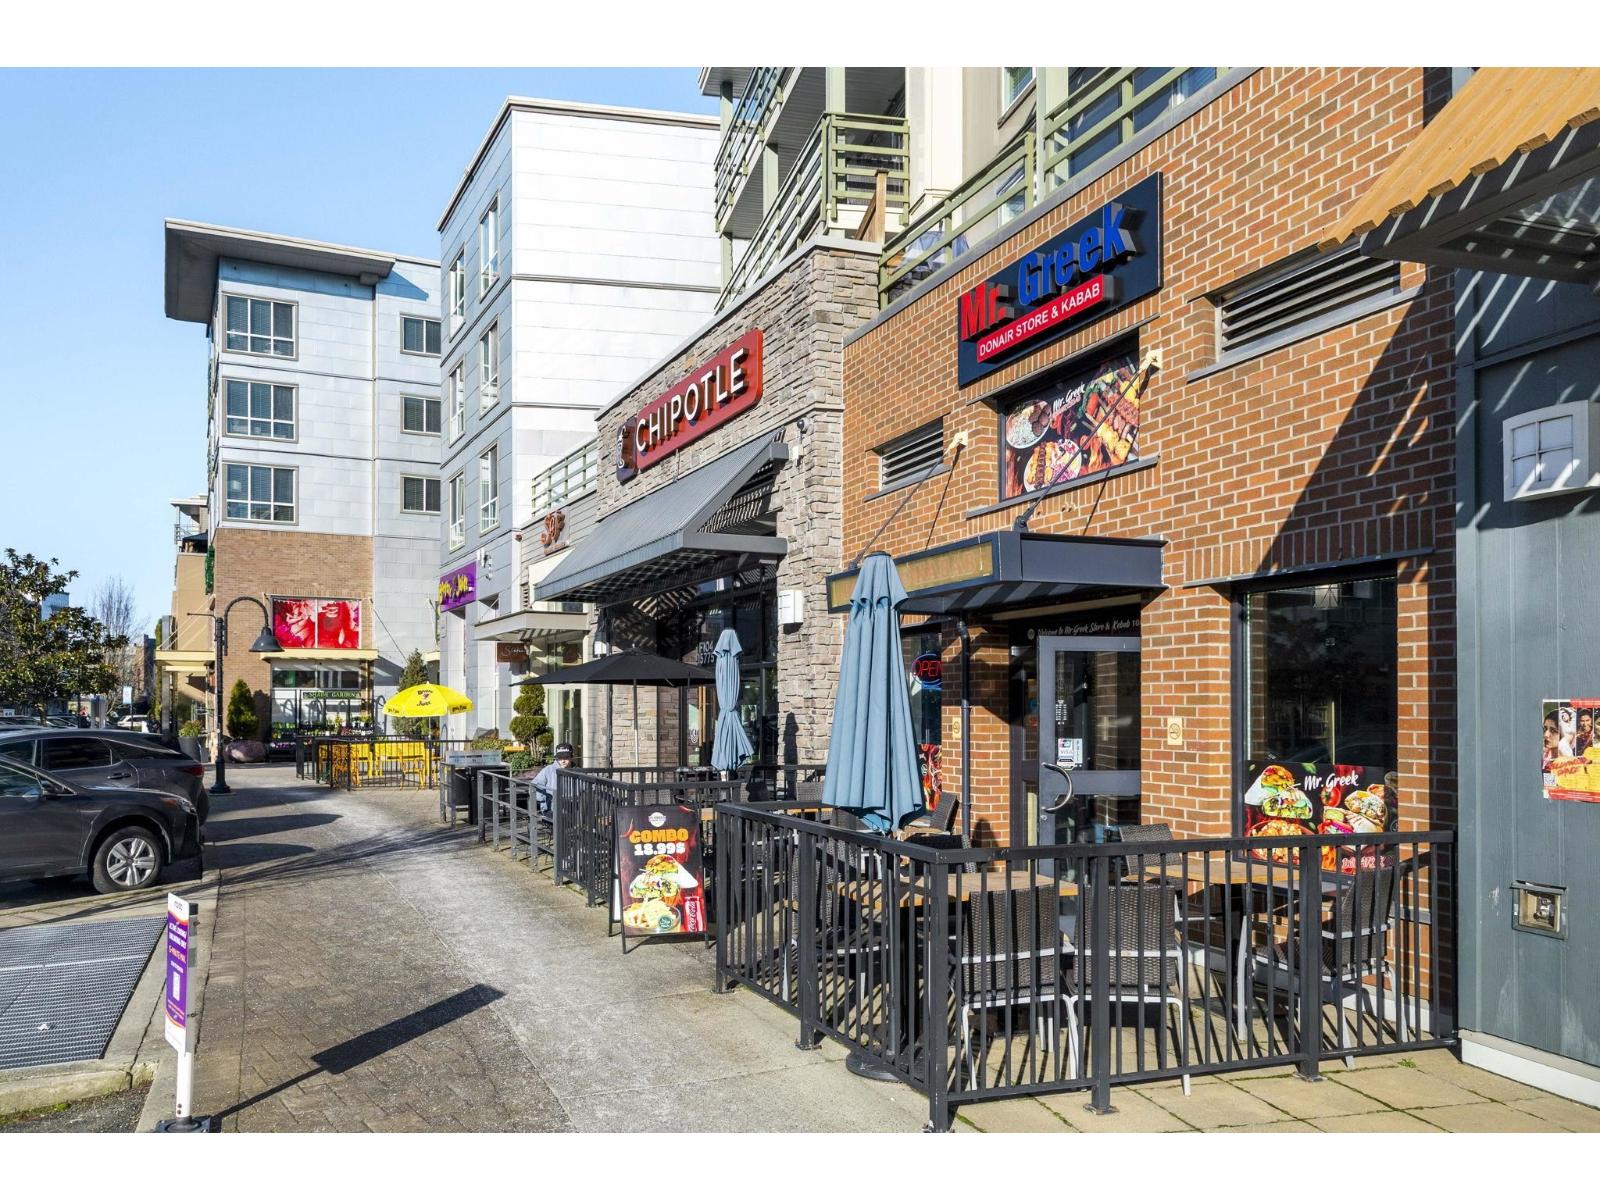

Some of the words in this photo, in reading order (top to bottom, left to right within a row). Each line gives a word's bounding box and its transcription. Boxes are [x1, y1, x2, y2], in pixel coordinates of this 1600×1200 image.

[961, 282, 1006, 341] Mr.
[1018, 202, 1133, 306] Greek
[979, 331, 1014, 357] DONAIR
[1015, 312, 1049, 338] STORE
[1050, 306, 1059, 320] &
[1061, 282, 1100, 314] KABAB
[635, 347, 746, 452] CHIPOTLE
[1304, 775, 1325, 791] Mr.
[1326, 770, 1360, 792] Greek
[629, 828, 689, 844] COMBO
